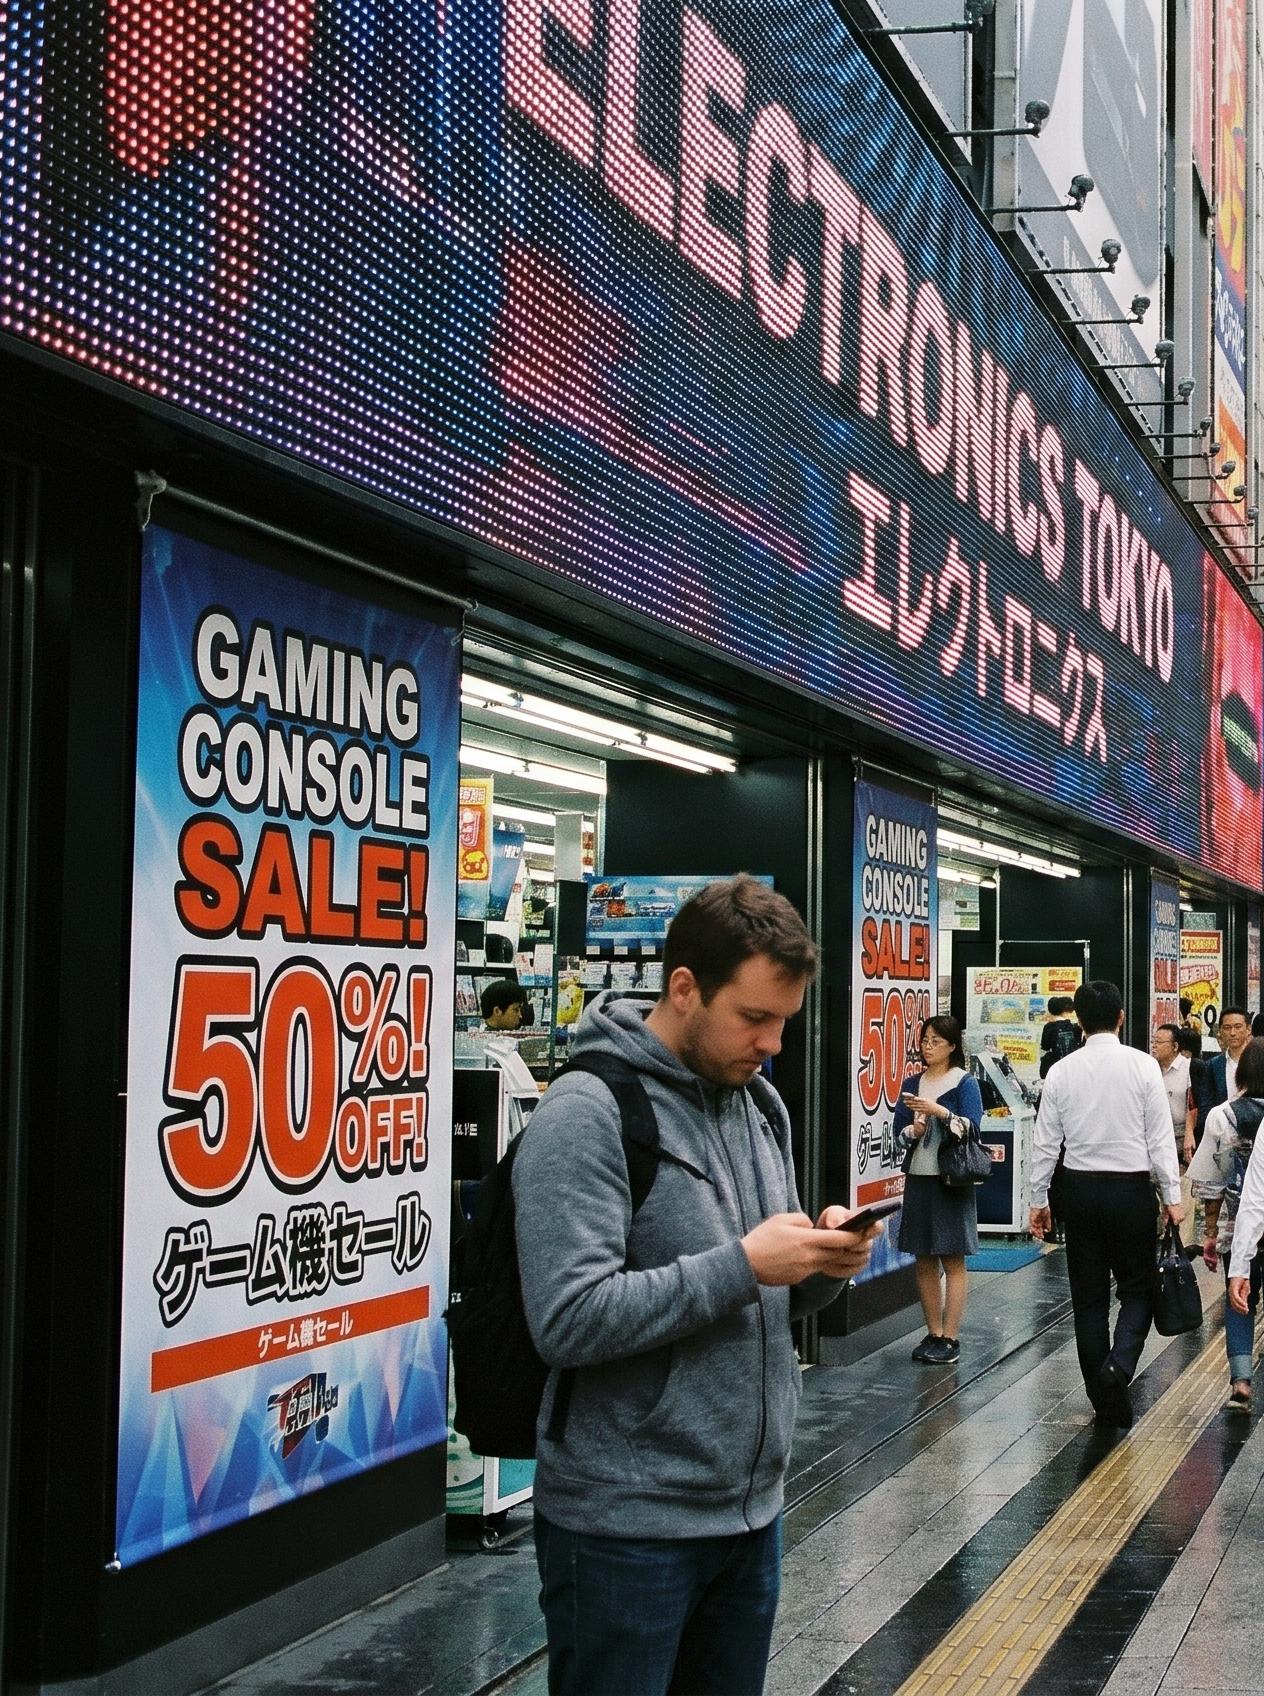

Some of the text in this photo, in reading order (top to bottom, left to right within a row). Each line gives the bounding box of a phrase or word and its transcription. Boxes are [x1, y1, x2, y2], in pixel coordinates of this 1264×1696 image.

[842, 470, 1107, 764] エレクトロニクス
[1073, 458, 1174, 684] TOKYO
[196, 612, 420, 743] GAMING
[181, 712, 430, 832] CONSOLE
[178, 818, 430, 944] SALE!
[862, 865, 930, 918] CONSOLE
[865, 814, 928, 870] GAMING
[862, 918, 930, 979] SALE!
[335, 1093, 429, 1176] OFF!
[158, 1193, 430, 1326] ゲーム機セール
